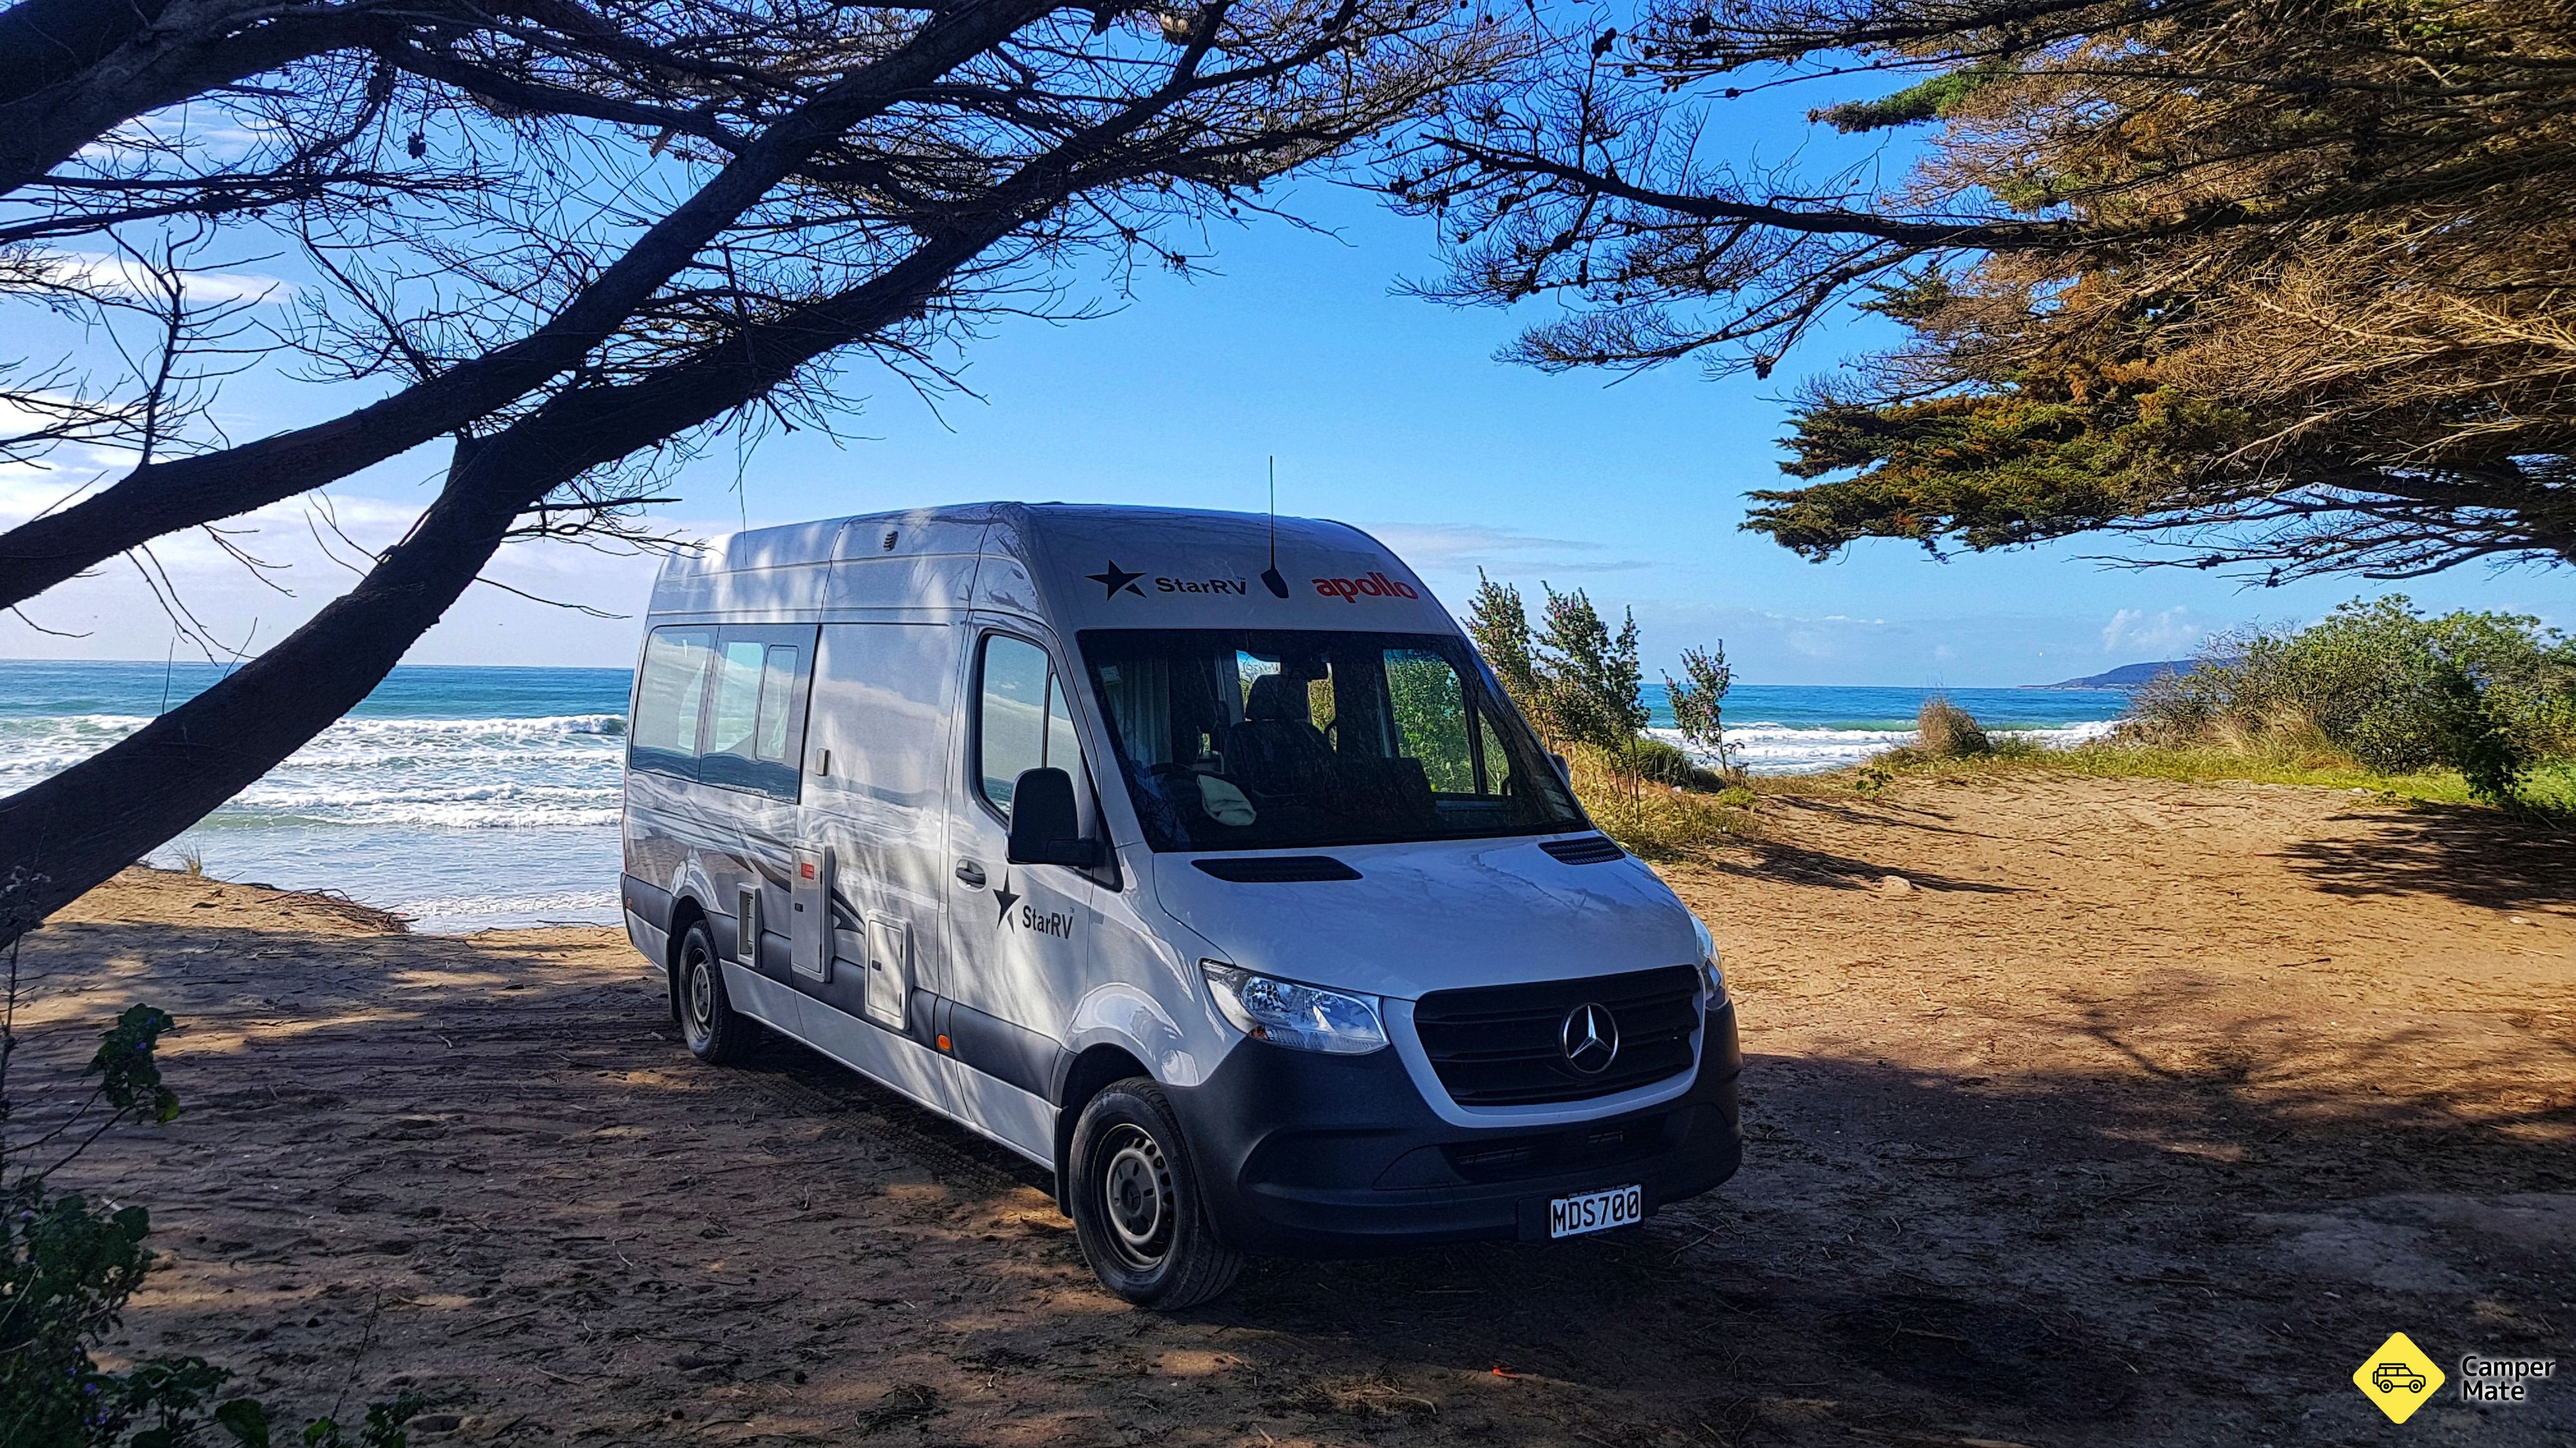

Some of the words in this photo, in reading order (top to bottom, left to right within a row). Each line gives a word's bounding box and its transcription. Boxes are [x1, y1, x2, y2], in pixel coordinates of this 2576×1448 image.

[1155, 578, 1247, 596] StarRV
[1311, 572, 1419, 604] apollo
[1022, 905, 1074, 940] StarRV
[1553, 1190, 1639, 1234] MDS700
